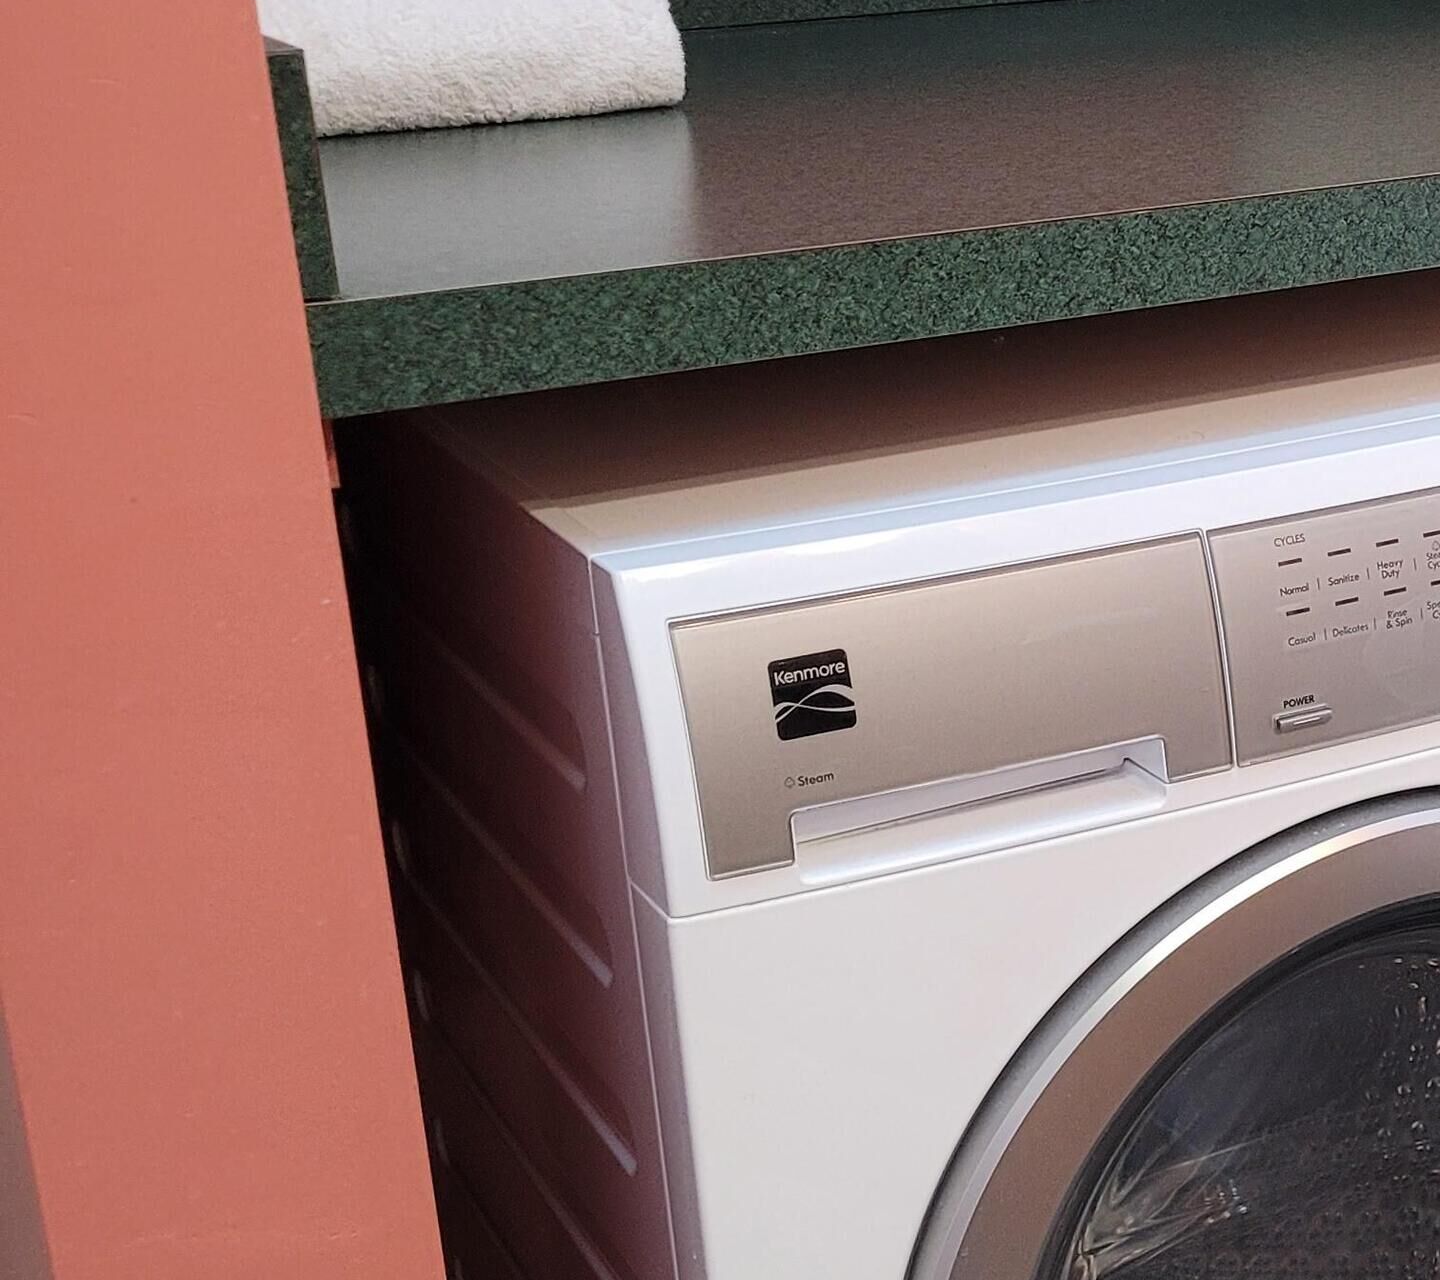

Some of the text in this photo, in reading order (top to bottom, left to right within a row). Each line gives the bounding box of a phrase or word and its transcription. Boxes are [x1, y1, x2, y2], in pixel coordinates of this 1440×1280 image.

[1274, 534, 1305, 547] CYCLES
[1377, 560, 1403, 570] Heavy
[1328, 574, 1359, 586] Sanitize
[1382, 570, 1400, 579] Duty
[1280, 583, 1309, 596] Normal
[1387, 609, 1407, 618] Rinse
[1395, 617, 1412, 628] Spin
[1333, 624, 1368, 637] Delicates
[1288, 633, 1316, 646] Casual
[774, 661, 845, 686] Kenmore
[1283, 695, 1314, 708] POWER
[798, 773, 834, 787] Steam
